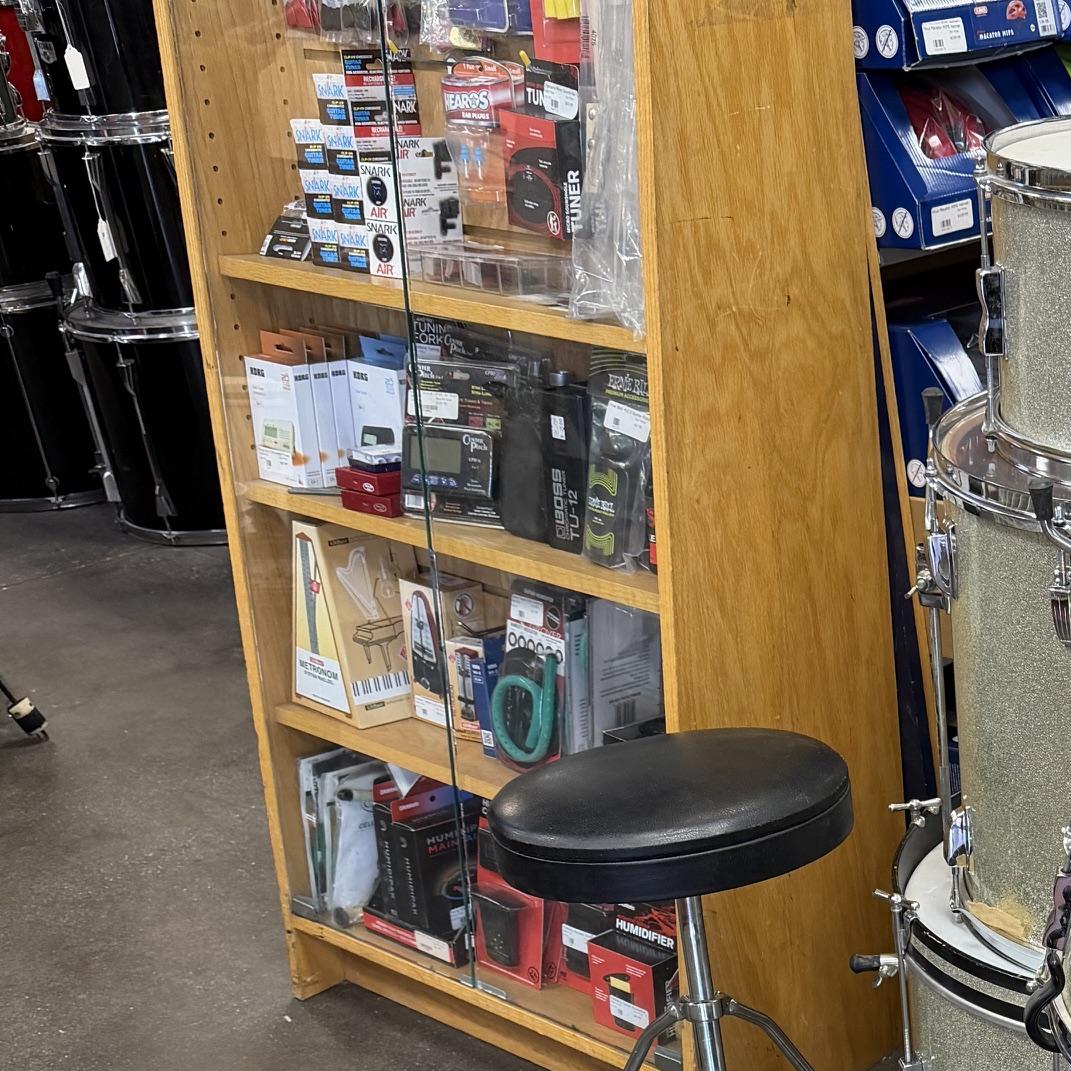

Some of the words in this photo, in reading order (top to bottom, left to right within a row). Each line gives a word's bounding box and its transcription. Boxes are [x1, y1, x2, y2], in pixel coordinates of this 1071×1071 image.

[443, 89, 488, 110] HEAROS
[394, 100, 417, 114] NARK
[360, 163, 391, 178] SNARK
[403, 198, 426, 210] NARK
[370, 206, 388, 219] AIR
[366, 222, 398, 236] SNARK
[376, 263, 395, 276] AIR
[250, 366, 265, 378] KORG
[294, 373, 310, 382] KORG
[313, 372, 329, 380] KORG
[331, 369, 347, 377] KORG
[353, 370, 369, 382] KORG
[552, 467, 565, 527] BOSS
[567, 489, 581, 541] TU-12
[299, 659, 339, 681] METRONOM
[616, 918, 676, 951] HUMIDIFIER
